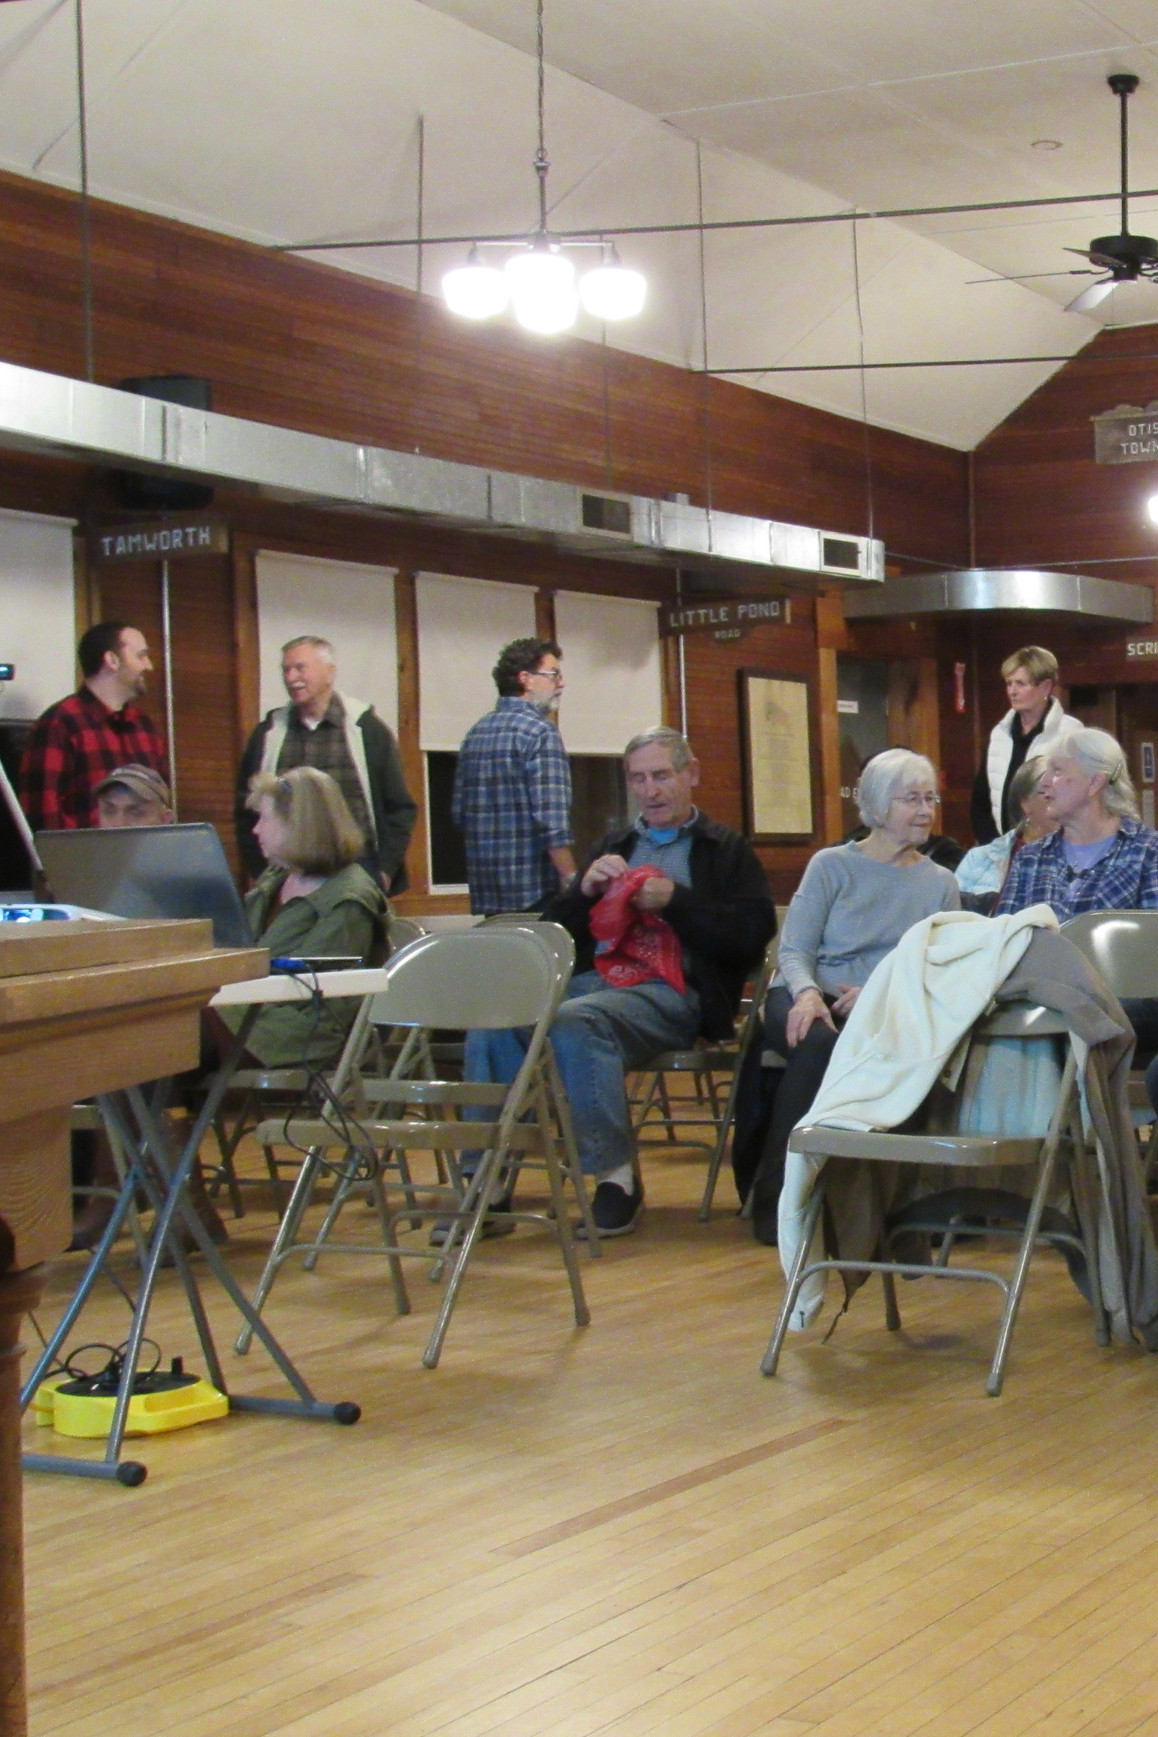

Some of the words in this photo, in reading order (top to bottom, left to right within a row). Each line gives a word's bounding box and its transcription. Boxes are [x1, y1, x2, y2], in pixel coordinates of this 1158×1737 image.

[101, 525, 211, 557] TAMWORTH
[669, 606, 729, 628] LITTLE
[738, 601, 780, 619] POND
